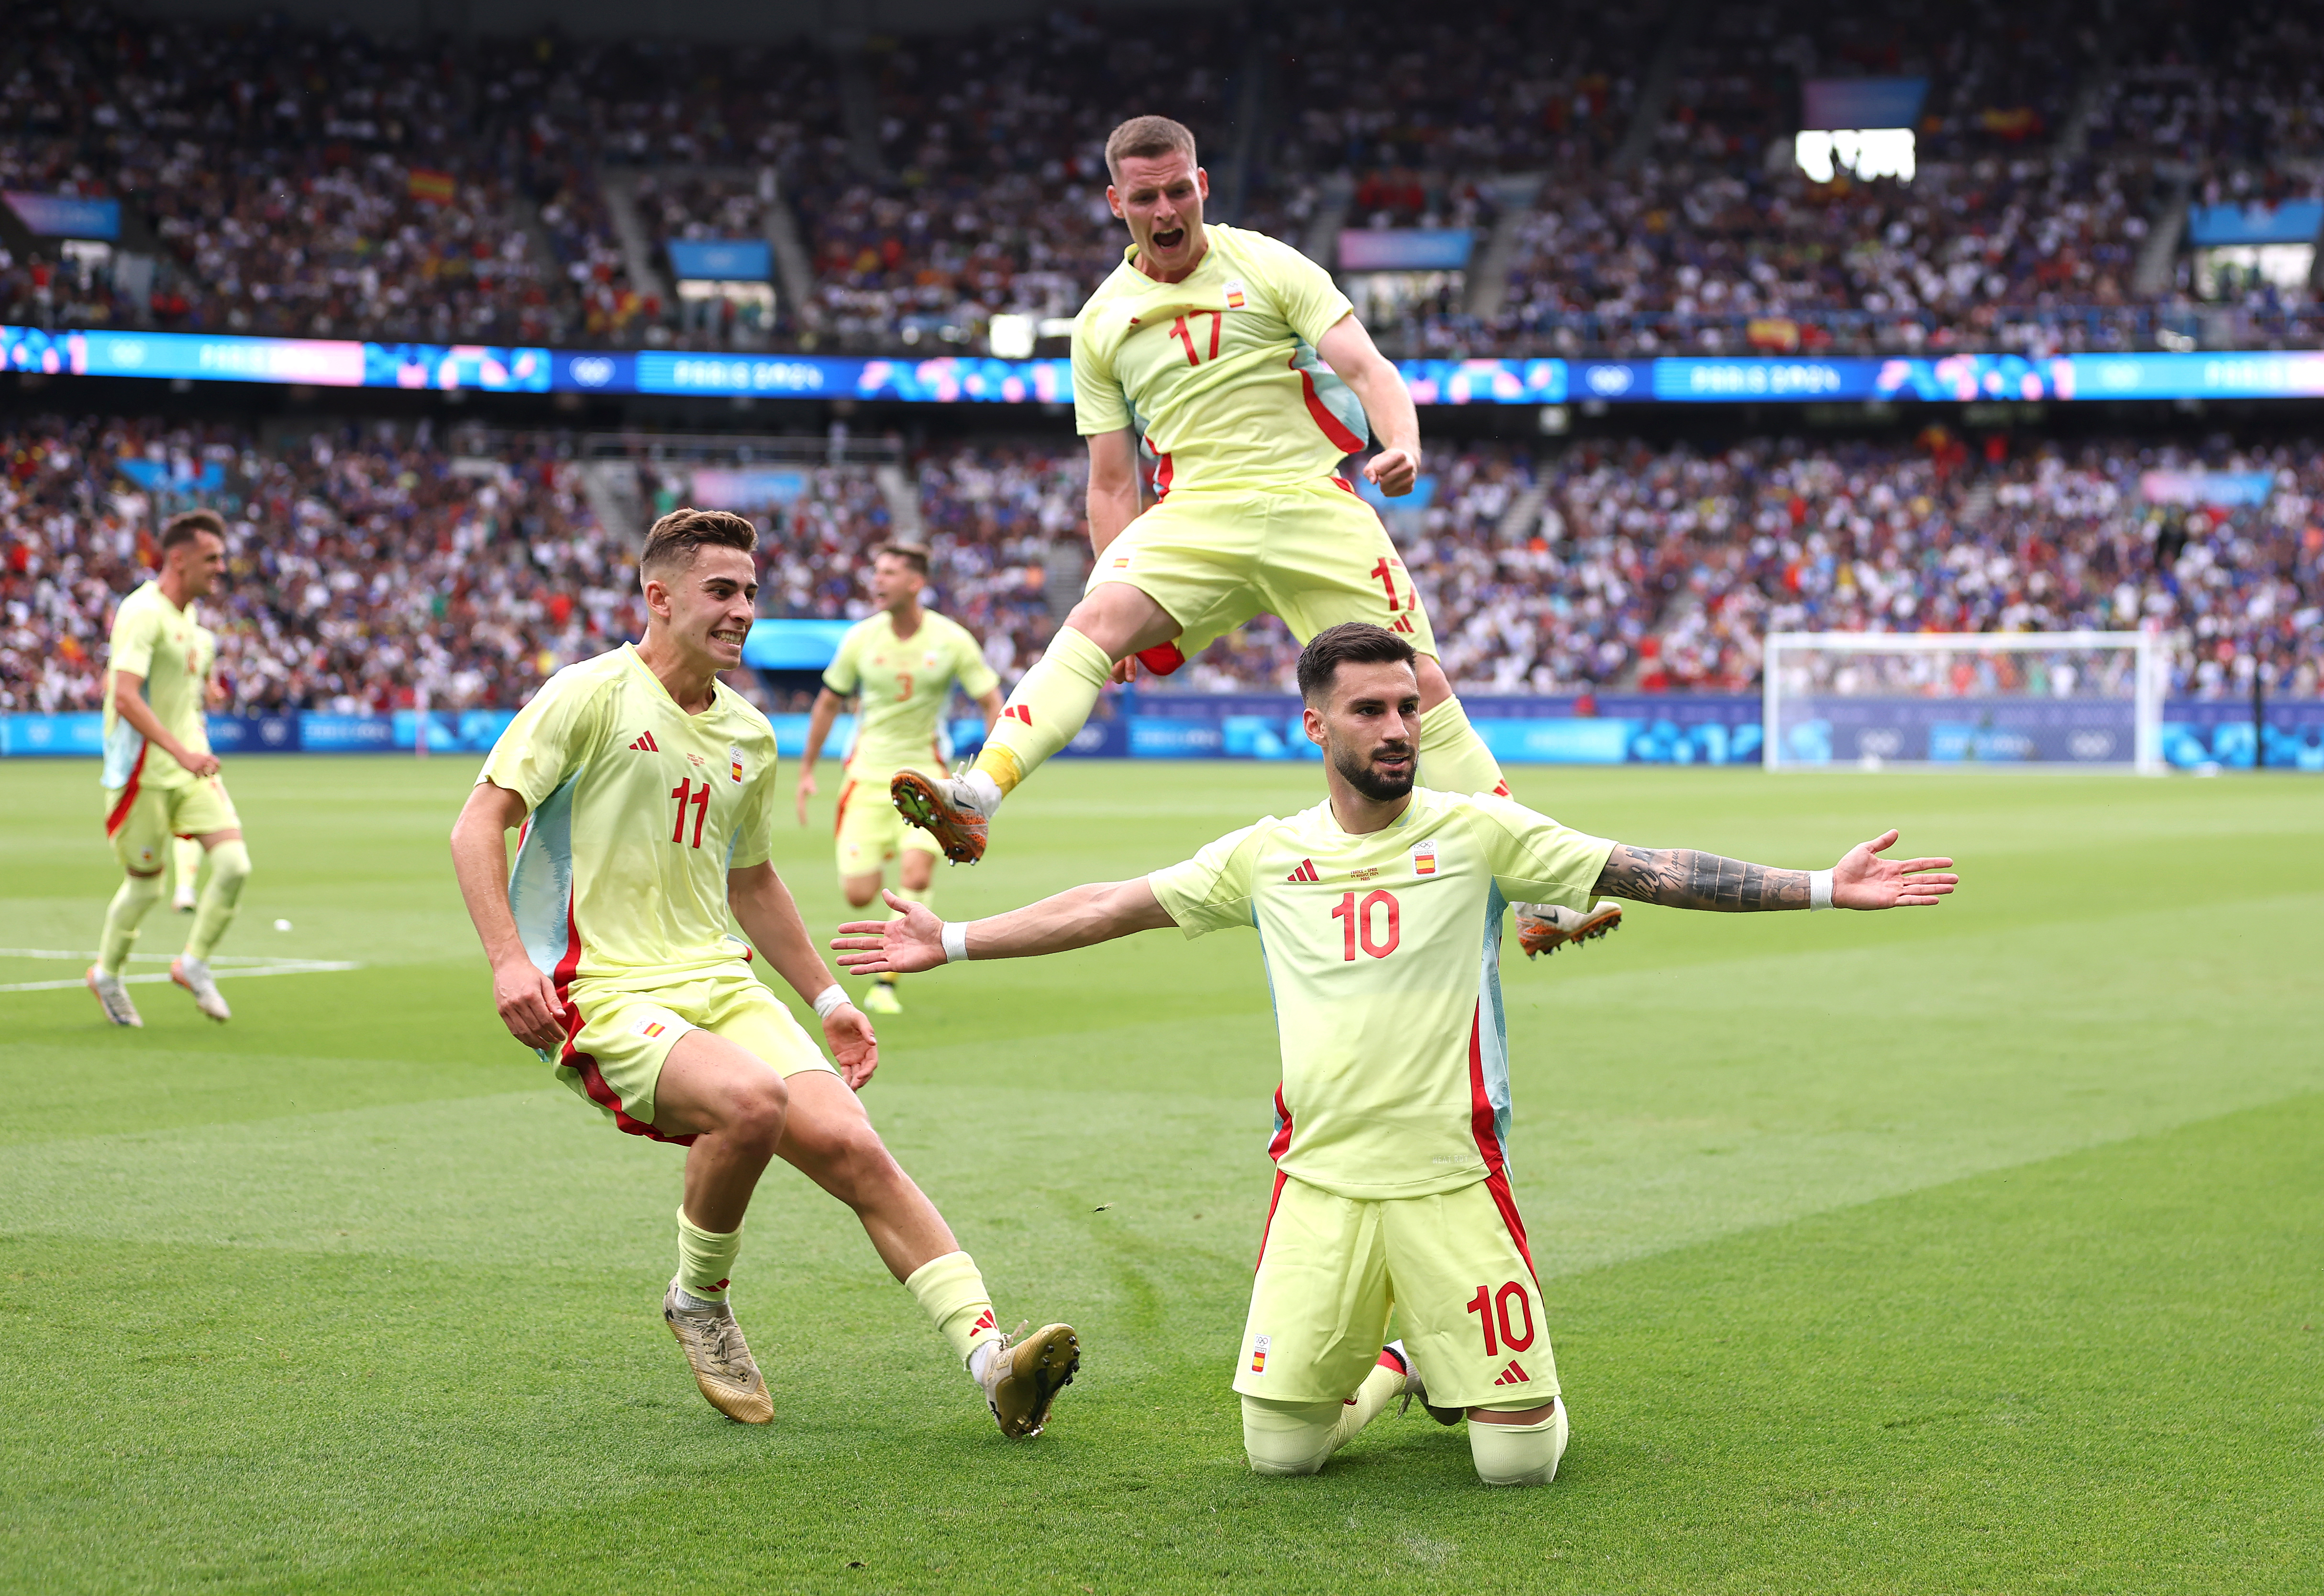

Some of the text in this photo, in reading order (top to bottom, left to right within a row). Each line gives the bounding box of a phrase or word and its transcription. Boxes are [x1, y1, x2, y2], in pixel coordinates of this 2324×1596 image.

[1169, 309, 1221, 366] 17
[1371, 557, 1416, 611] 17
[894, 672, 914, 702] 3
[671, 777, 710, 848] 11
[1659, 849, 1687, 889] Migue
[1332, 889, 1400, 961] 10
[1467, 1281, 1535, 1356] 10
